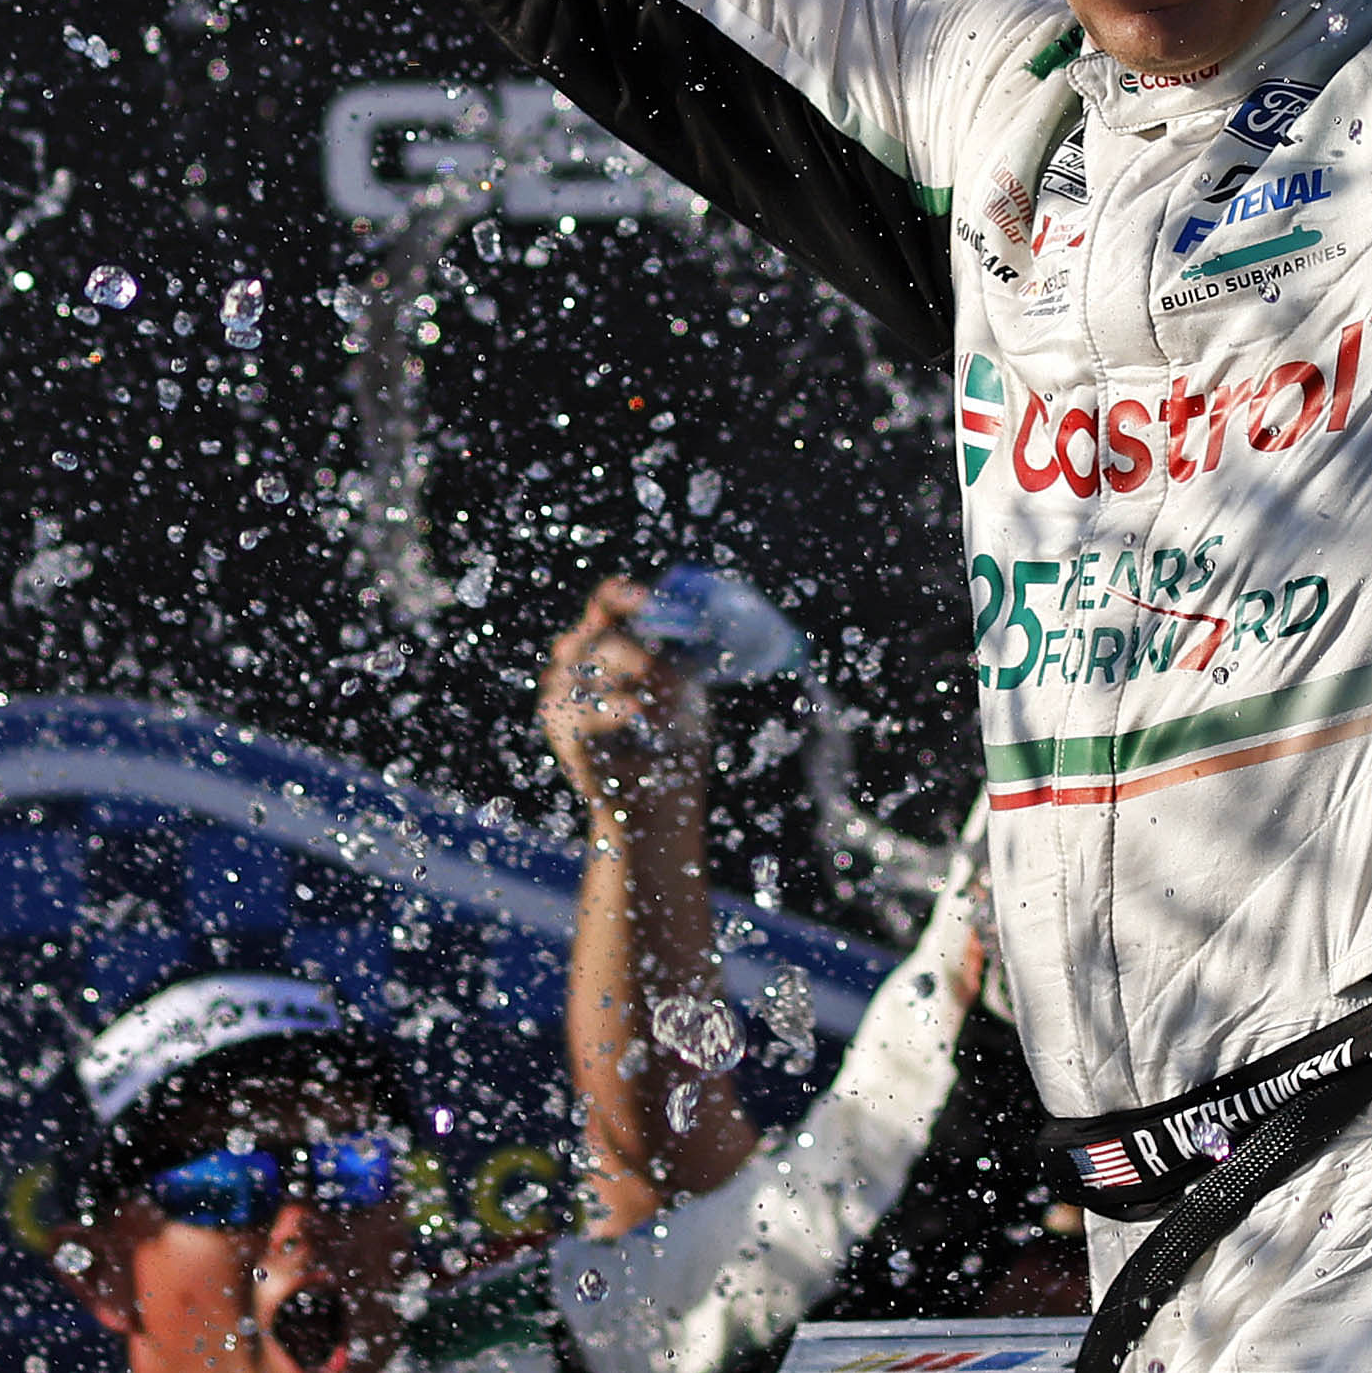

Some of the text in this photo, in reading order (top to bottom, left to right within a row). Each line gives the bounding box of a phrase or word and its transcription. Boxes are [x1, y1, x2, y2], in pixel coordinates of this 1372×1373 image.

[1160, 243, 1349, 312] BUILD SUBMARINES
[1012, 319, 1364, 498] Castrol
